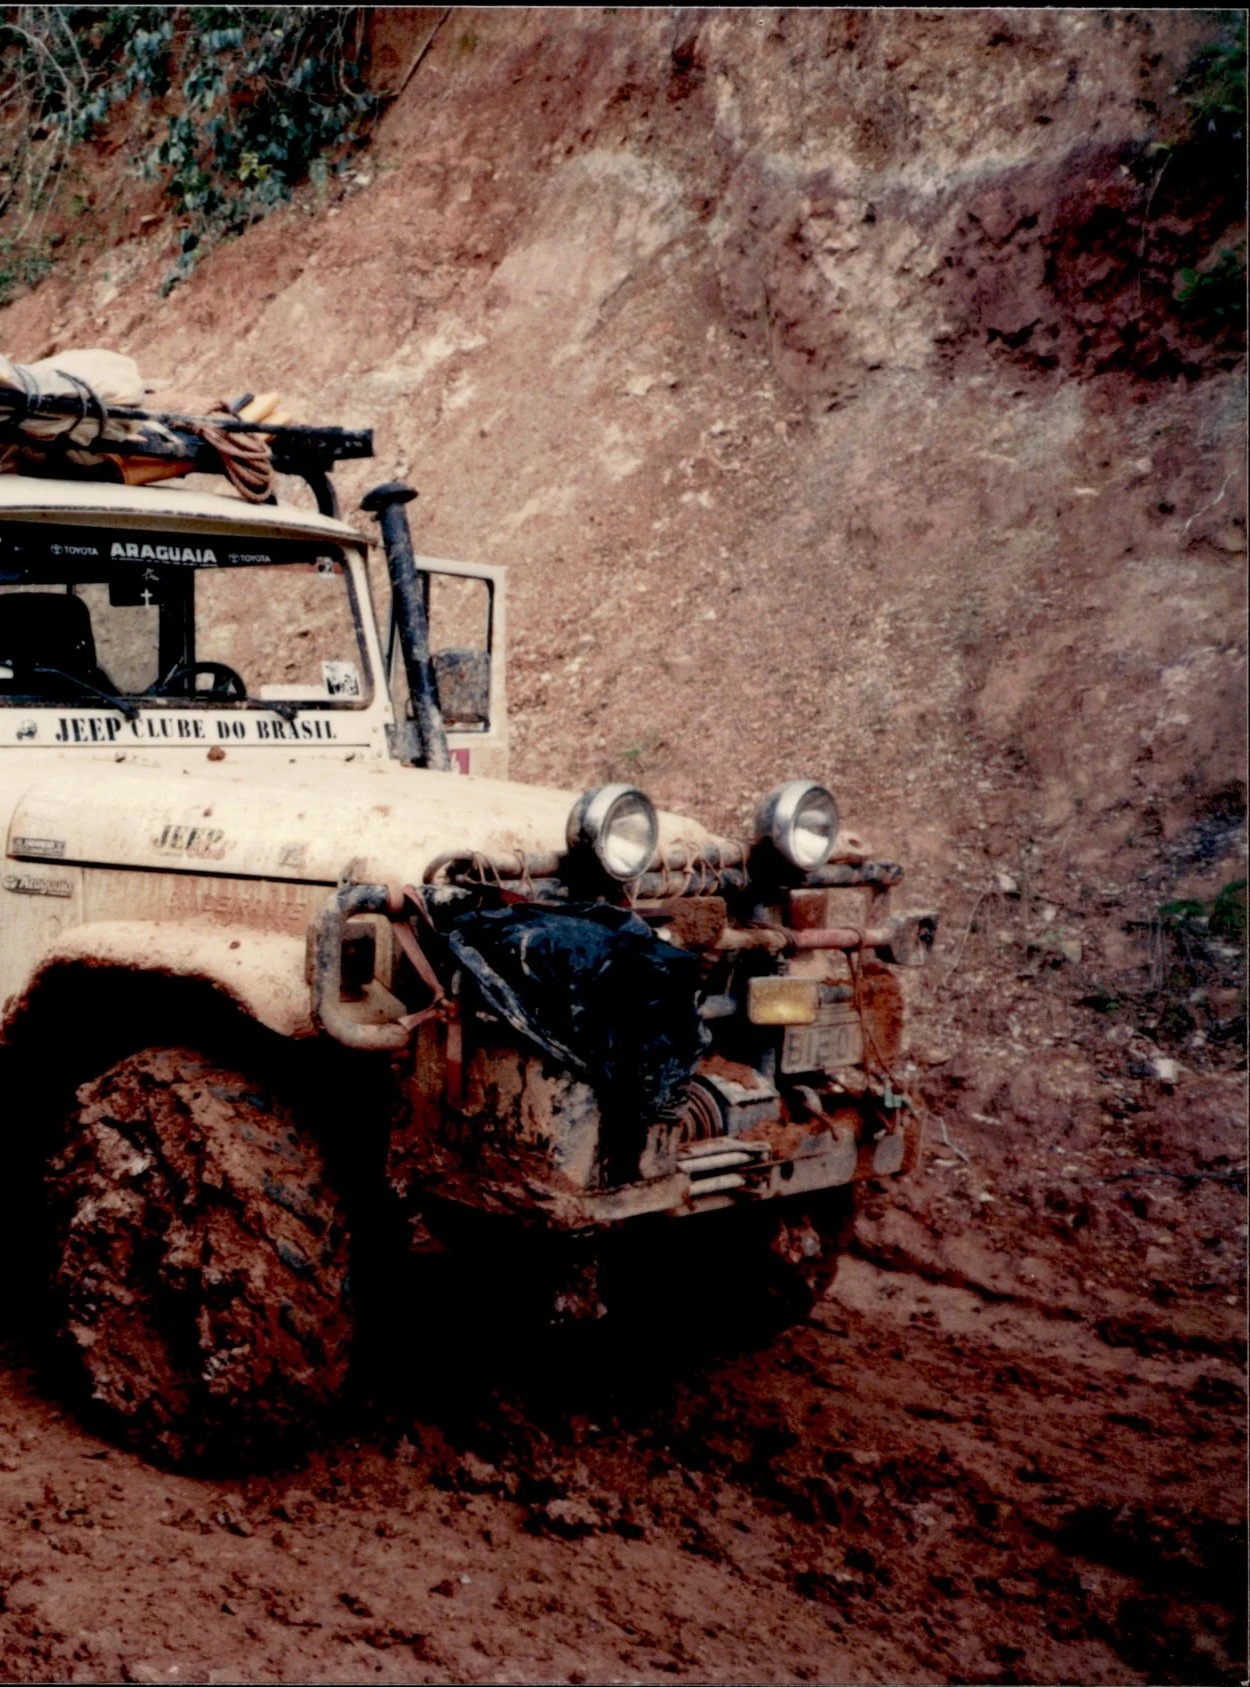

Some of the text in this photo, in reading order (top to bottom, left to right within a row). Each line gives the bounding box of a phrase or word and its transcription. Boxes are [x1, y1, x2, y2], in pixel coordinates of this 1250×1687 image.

[64, 545, 99, 556] TOYOTA
[110, 542, 218, 563] ARAGUAIA
[240, 554, 272, 563] TOYOTA
[55, 717, 337, 743] JEEP CLUBE DO BRASIL
